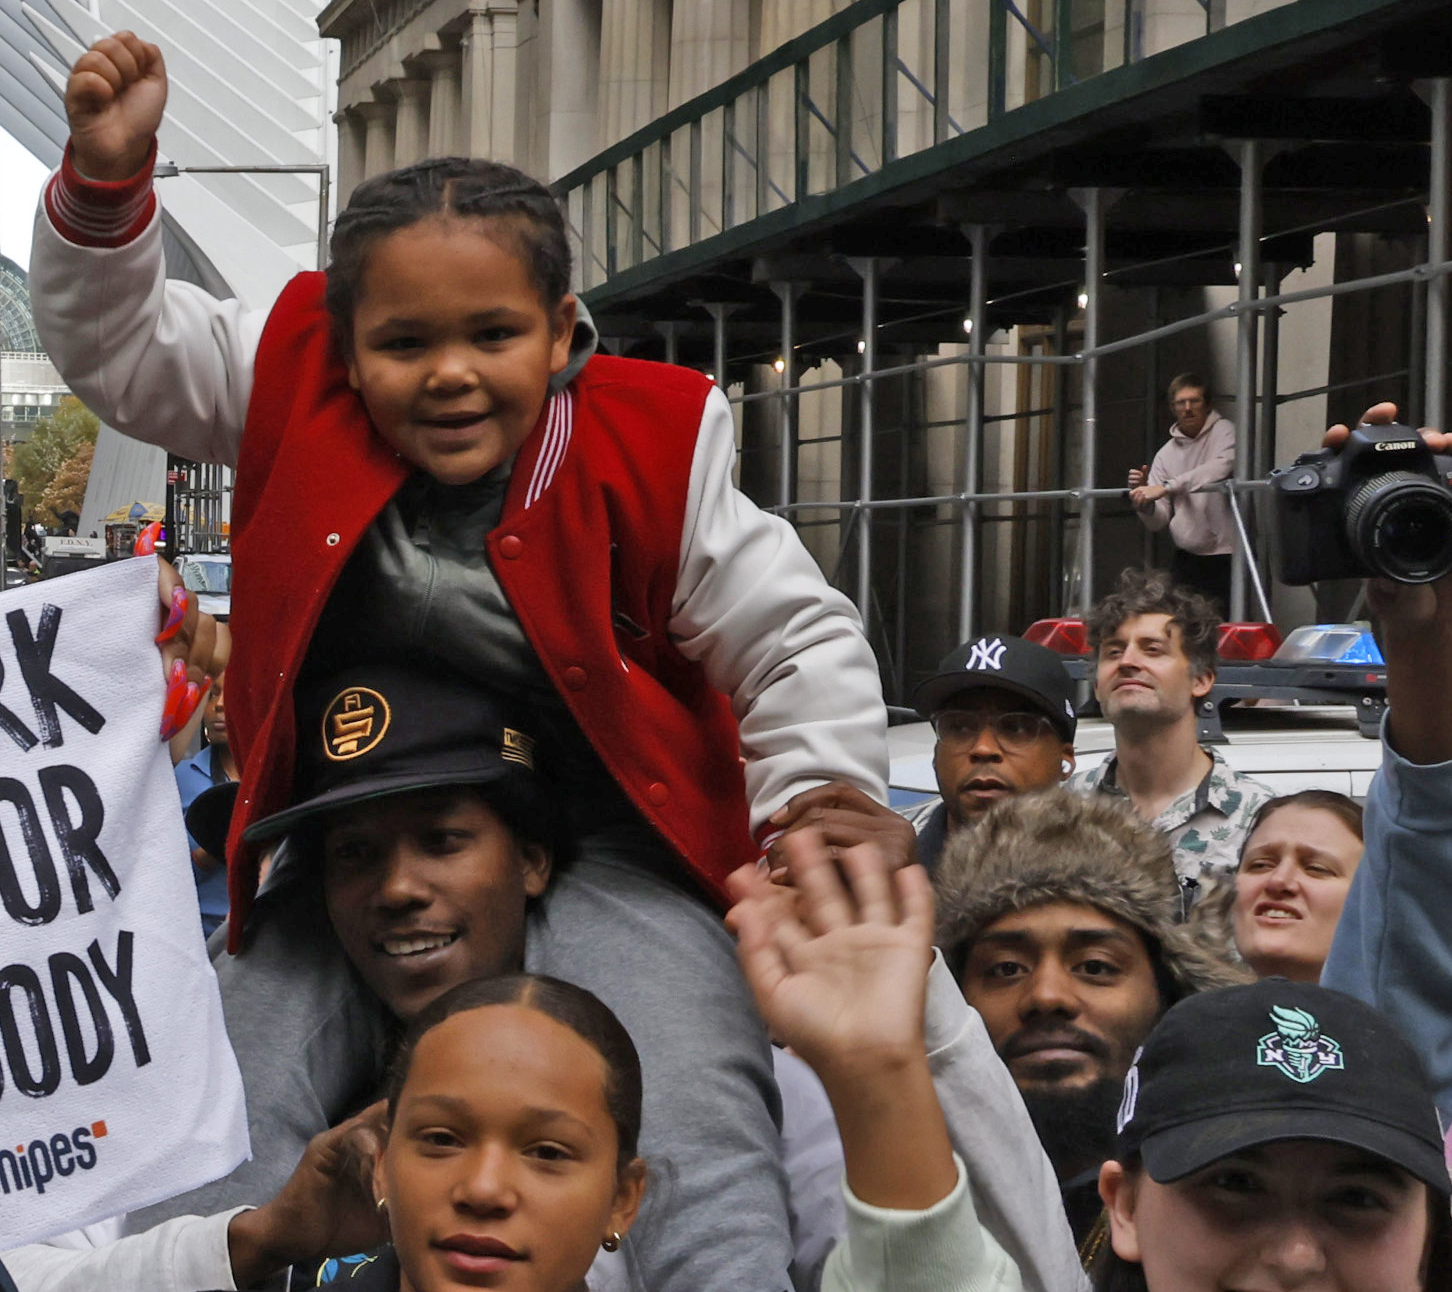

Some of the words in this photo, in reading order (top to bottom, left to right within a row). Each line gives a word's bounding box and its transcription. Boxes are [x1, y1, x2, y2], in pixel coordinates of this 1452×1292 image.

[1375, 440, 1416, 452] Canon
[60, 538, 94, 548] F.D.N.Y.
[965, 637, 1008, 670] NY
